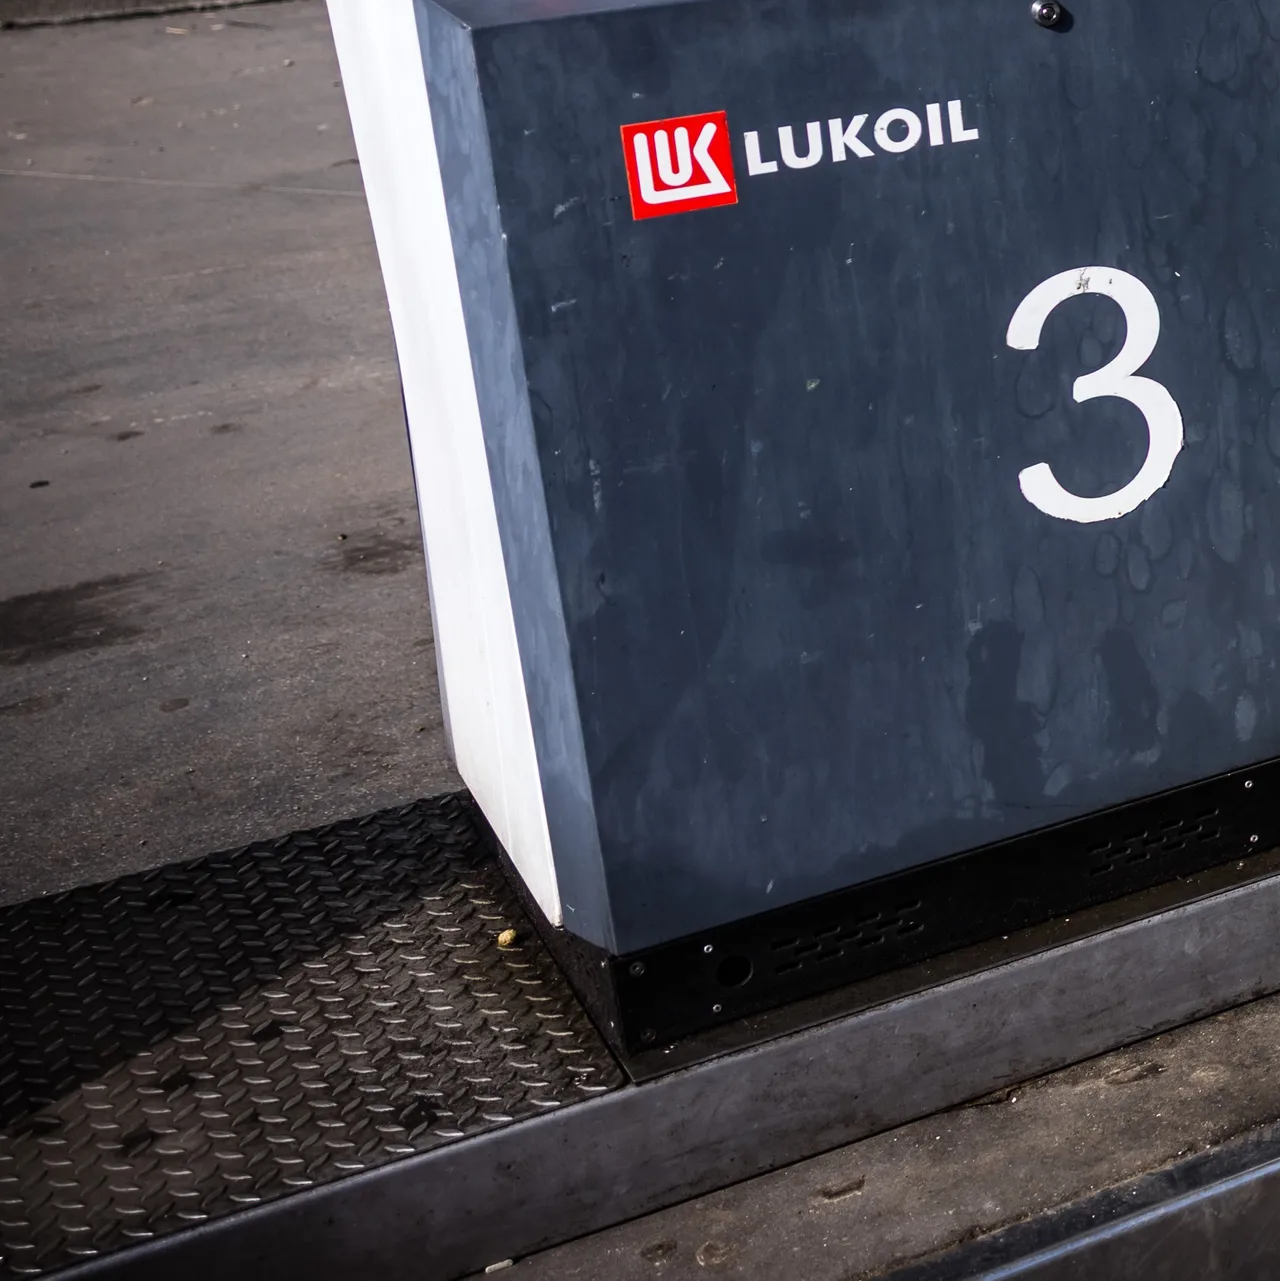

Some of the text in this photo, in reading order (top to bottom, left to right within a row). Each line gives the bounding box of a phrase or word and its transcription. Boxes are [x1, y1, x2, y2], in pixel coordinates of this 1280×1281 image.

[633, 100, 980, 204] LUK LUKOIL
[1006, 265, 1185, 524] 3
